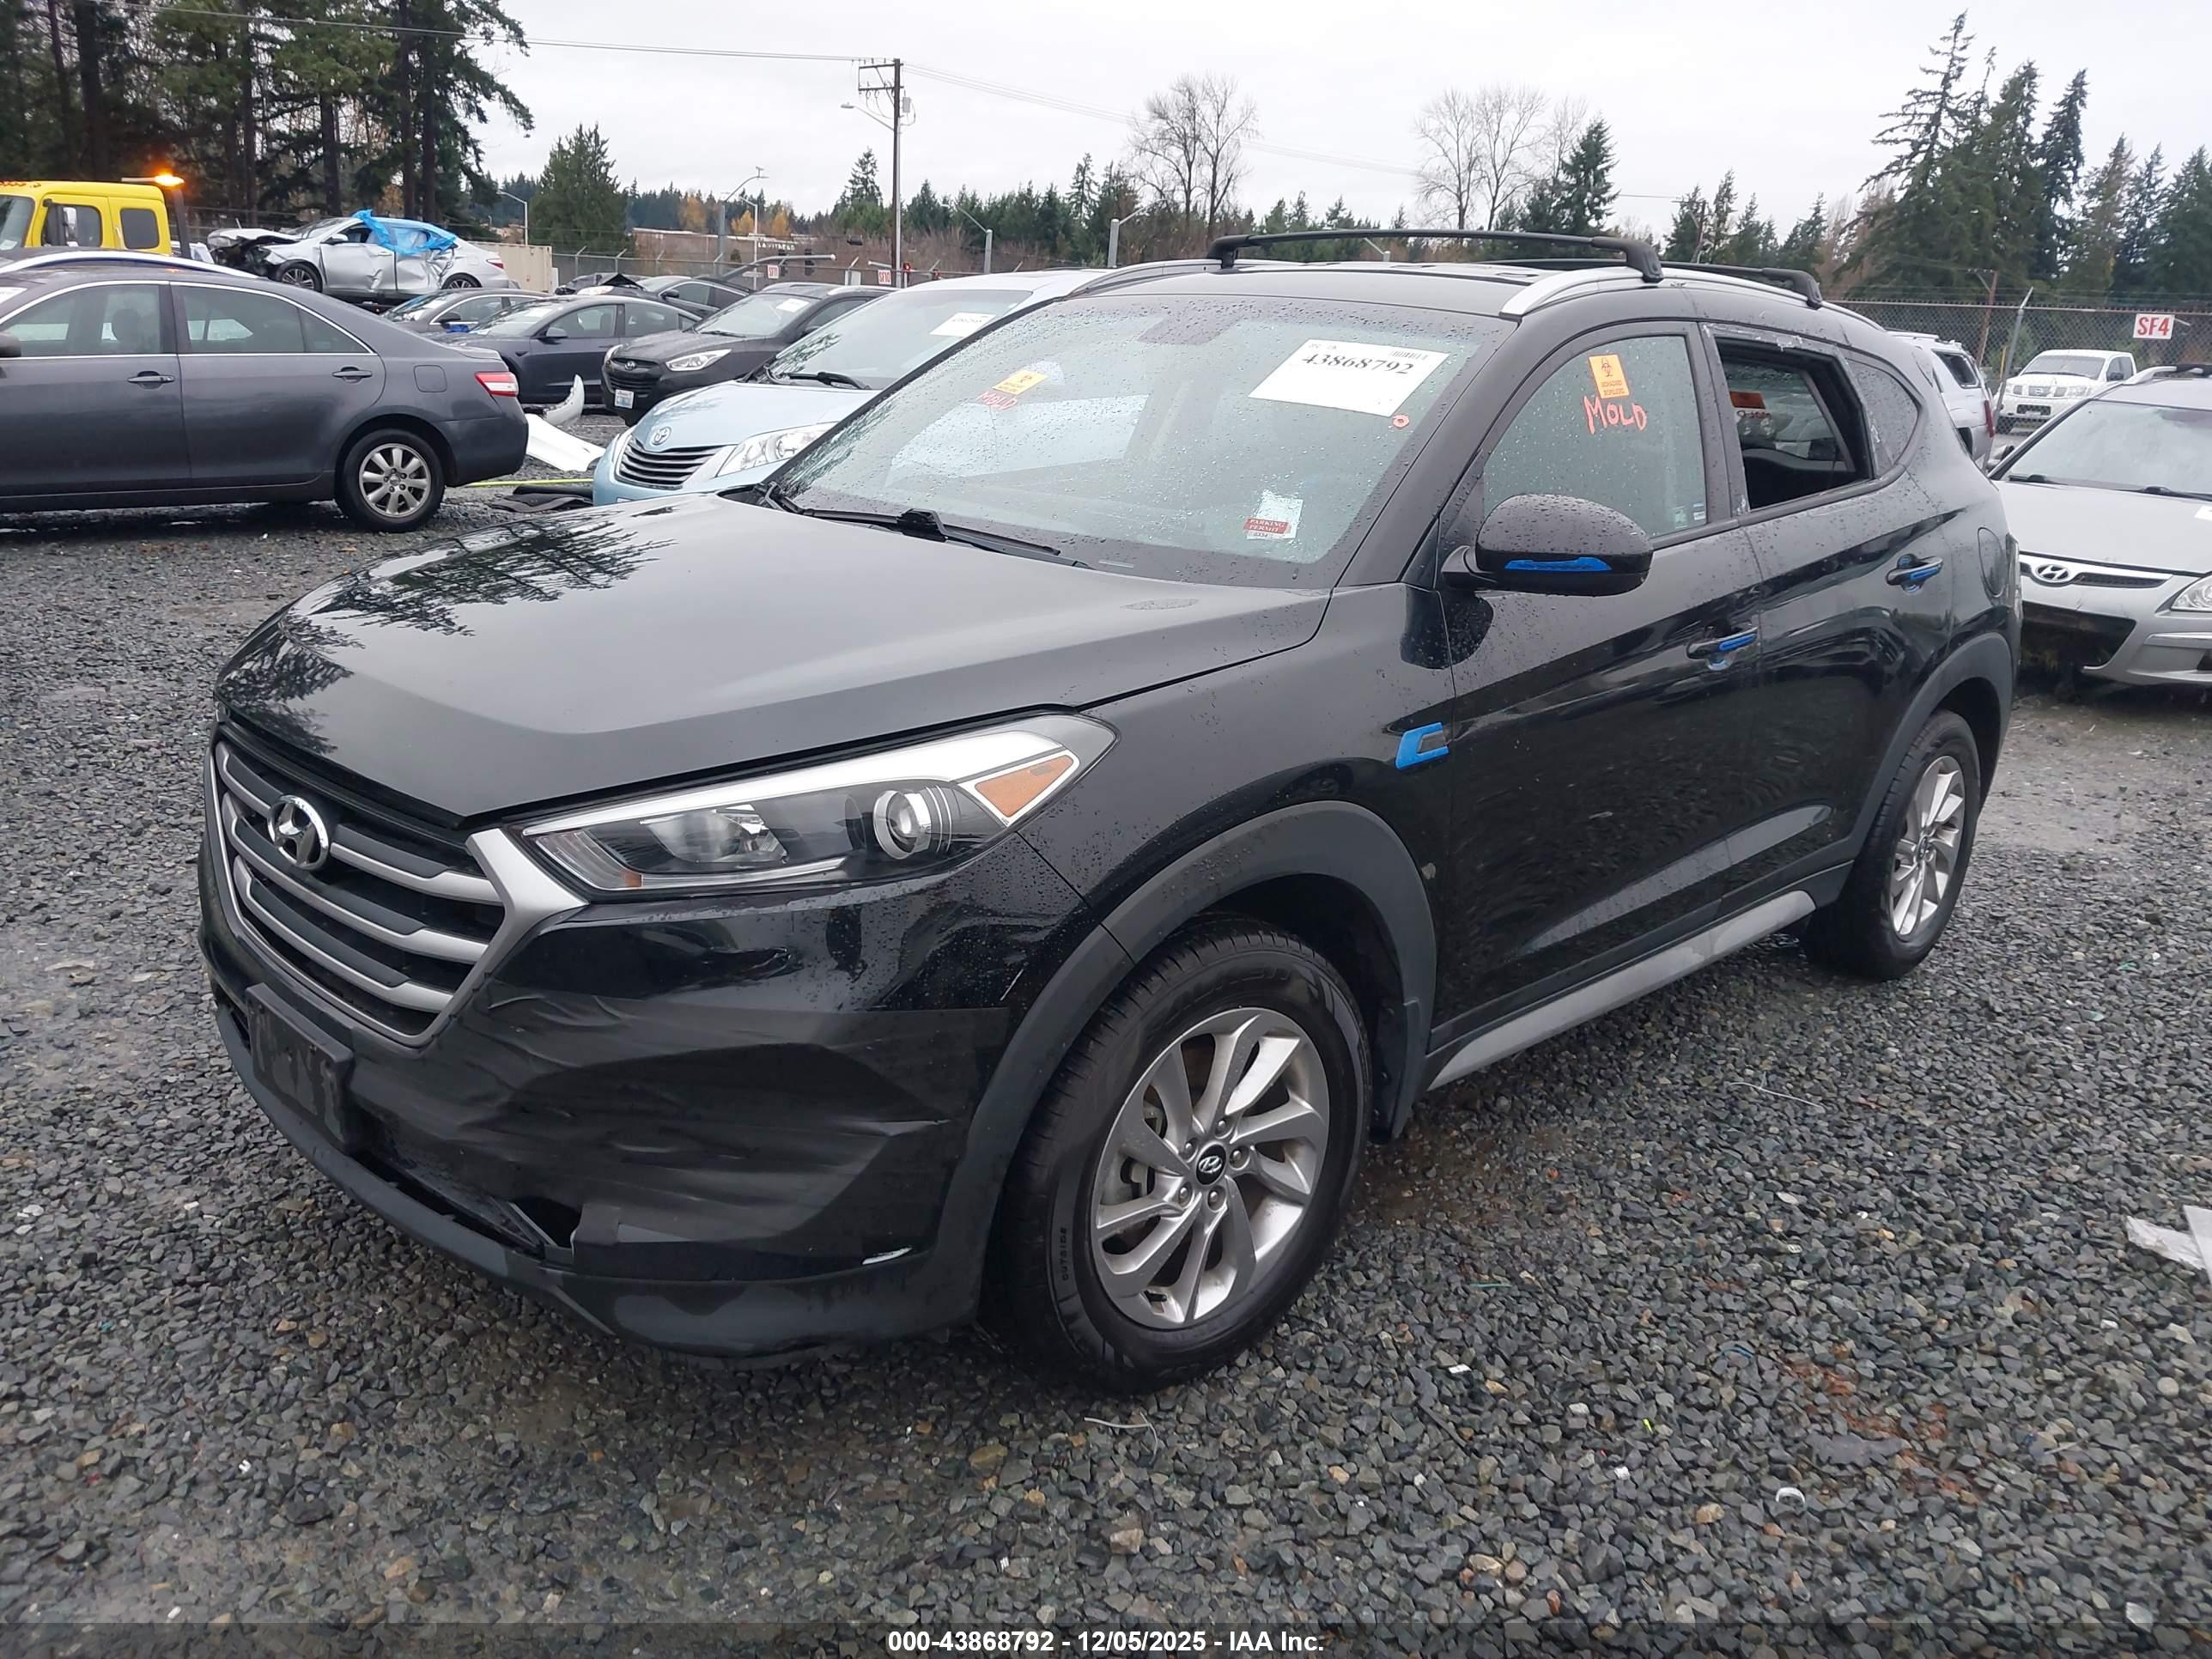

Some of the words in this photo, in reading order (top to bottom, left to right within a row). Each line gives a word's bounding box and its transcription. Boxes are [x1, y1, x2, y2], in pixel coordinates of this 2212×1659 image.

[2137, 316, 2170, 336] SF4
[1302, 353, 1414, 374] 43868792
[975, 391, 1018, 410] MOLD
[1583, 395, 1648, 434] MOLD
[1249, 519, 1285, 527] PARKING
[1059, 1227, 1070, 1281] OUTSIDE
